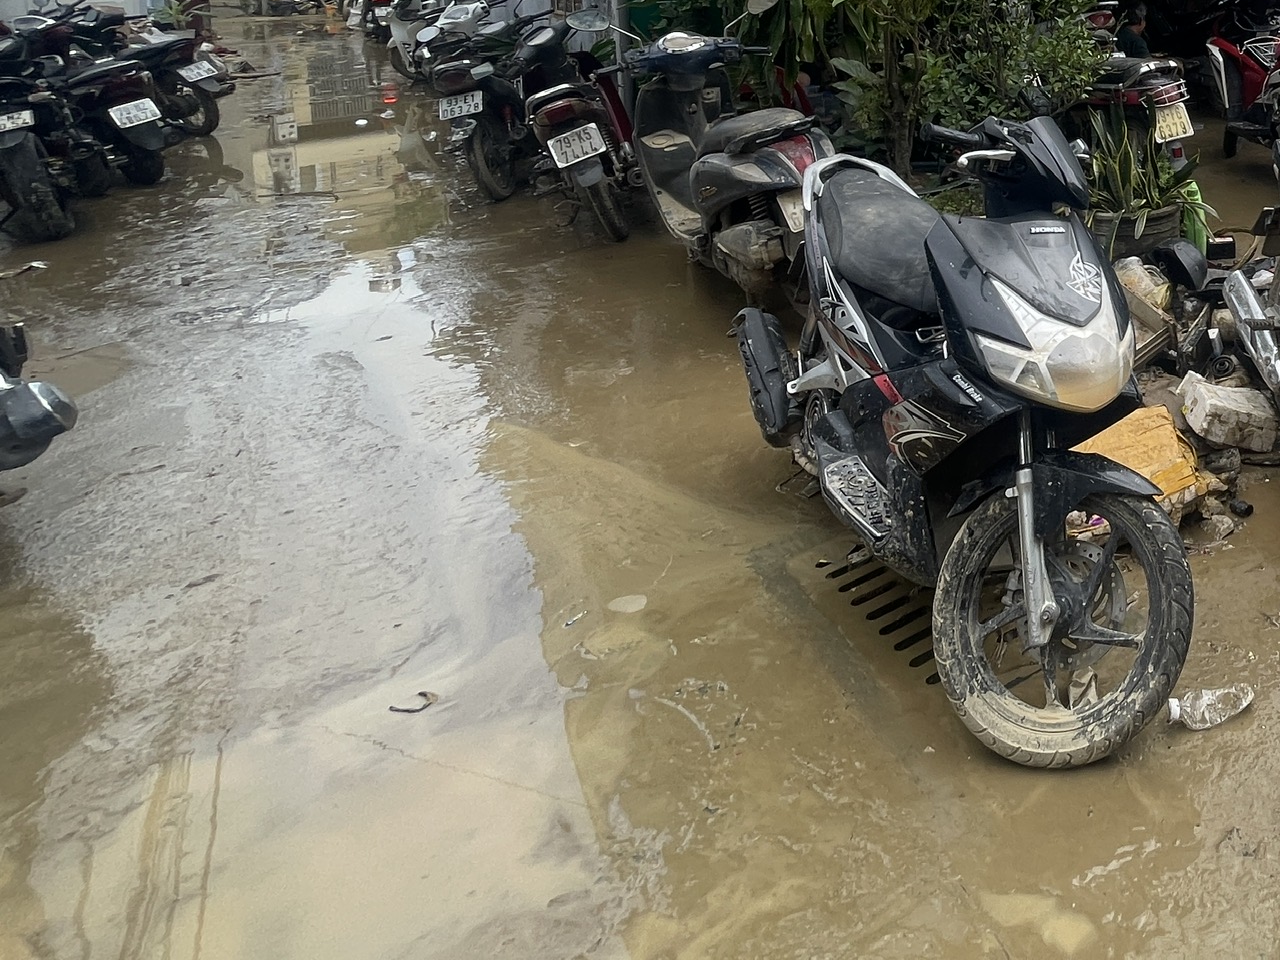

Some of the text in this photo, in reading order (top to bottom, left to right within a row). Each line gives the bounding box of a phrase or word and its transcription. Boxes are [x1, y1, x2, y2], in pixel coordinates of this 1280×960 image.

[446, 95, 475, 108] 93-E1
[1159, 121, 1188, 139] 6379
[556, 128, 593, 152] 79-K5
[1031, 226, 1066, 234] HONDA
[953, 374, 982, 402] Combi Brake
